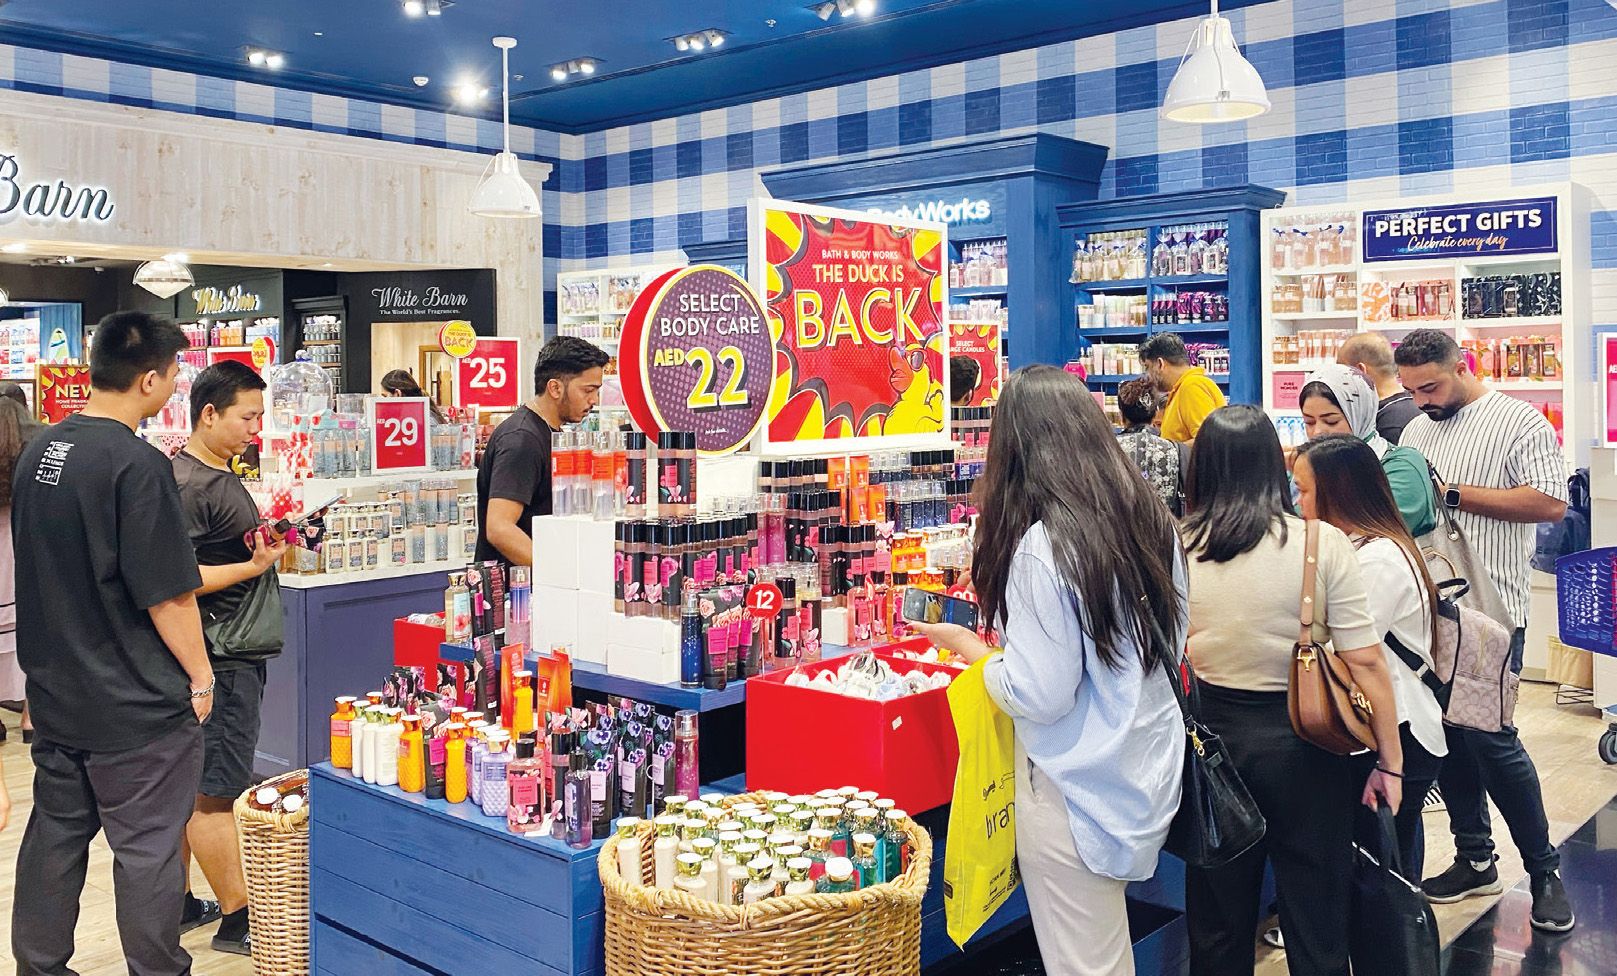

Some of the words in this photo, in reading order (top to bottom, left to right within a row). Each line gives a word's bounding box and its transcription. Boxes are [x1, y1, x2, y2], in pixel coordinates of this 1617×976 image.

[0, 154, 114, 220] Barn
[1375, 213, 1471, 238] PERFECT
[1475, 208, 1542, 231] GIFTS
[1407, 235, 1456, 252] Celebrate
[1456, 235, 1485, 252] every
[1485, 232, 1508, 250] day
[822, 249, 842, 260] BATH
[843, 250, 850, 259] &
[851, 250, 871, 260] BODY
[872, 251, 898, 260] WORKS
[813, 264, 843, 283] THE
[849, 265, 890, 283] DUCK
[892, 265, 904, 283] IS
[371, 286, 420, 308] White
[422, 286, 468, 307] Barn
[680, 293, 741, 313] SELECT
[660, 317, 710, 337] BODY
[715, 316, 760, 336] CARE
[794, 287, 927, 349] BACK
[445, 336, 473, 348] BACK
[469, 357, 507, 389] 25
[653, 347, 685, 367] AED
[684, 345, 749, 409] 22
[384, 416, 418, 447] 29
[755, 589, 775, 610] 12
